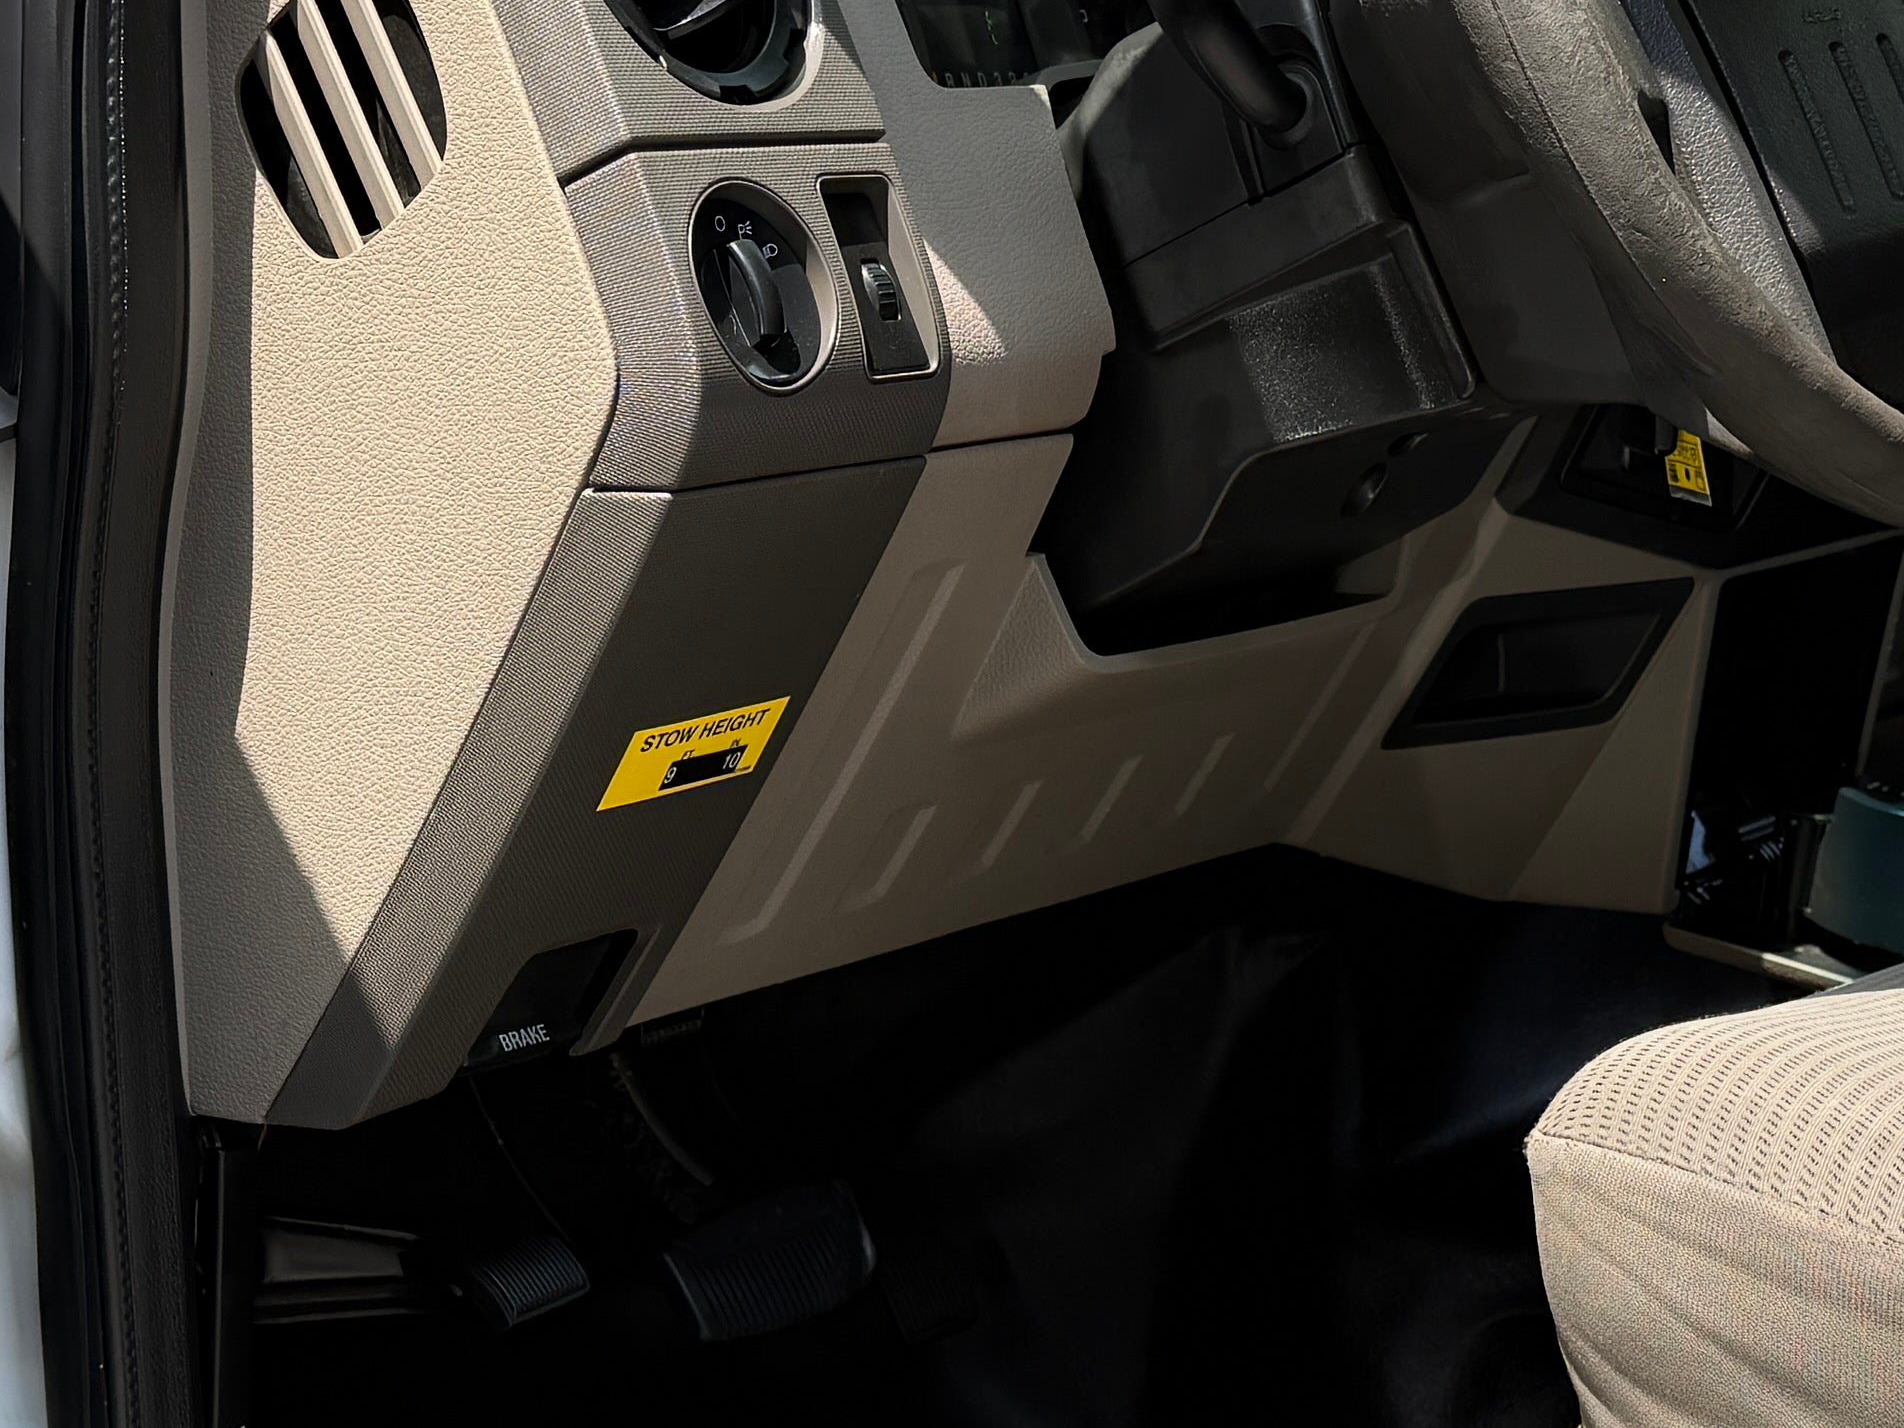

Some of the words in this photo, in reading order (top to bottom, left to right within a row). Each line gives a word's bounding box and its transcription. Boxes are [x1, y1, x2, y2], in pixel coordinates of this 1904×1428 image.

[640, 724, 699, 752] STOW
[699, 707, 771, 739] HEIGHT
[663, 766, 676, 784] 9
[722, 751, 741, 770] 10
[499, 1023, 550, 1052] BRAKE
